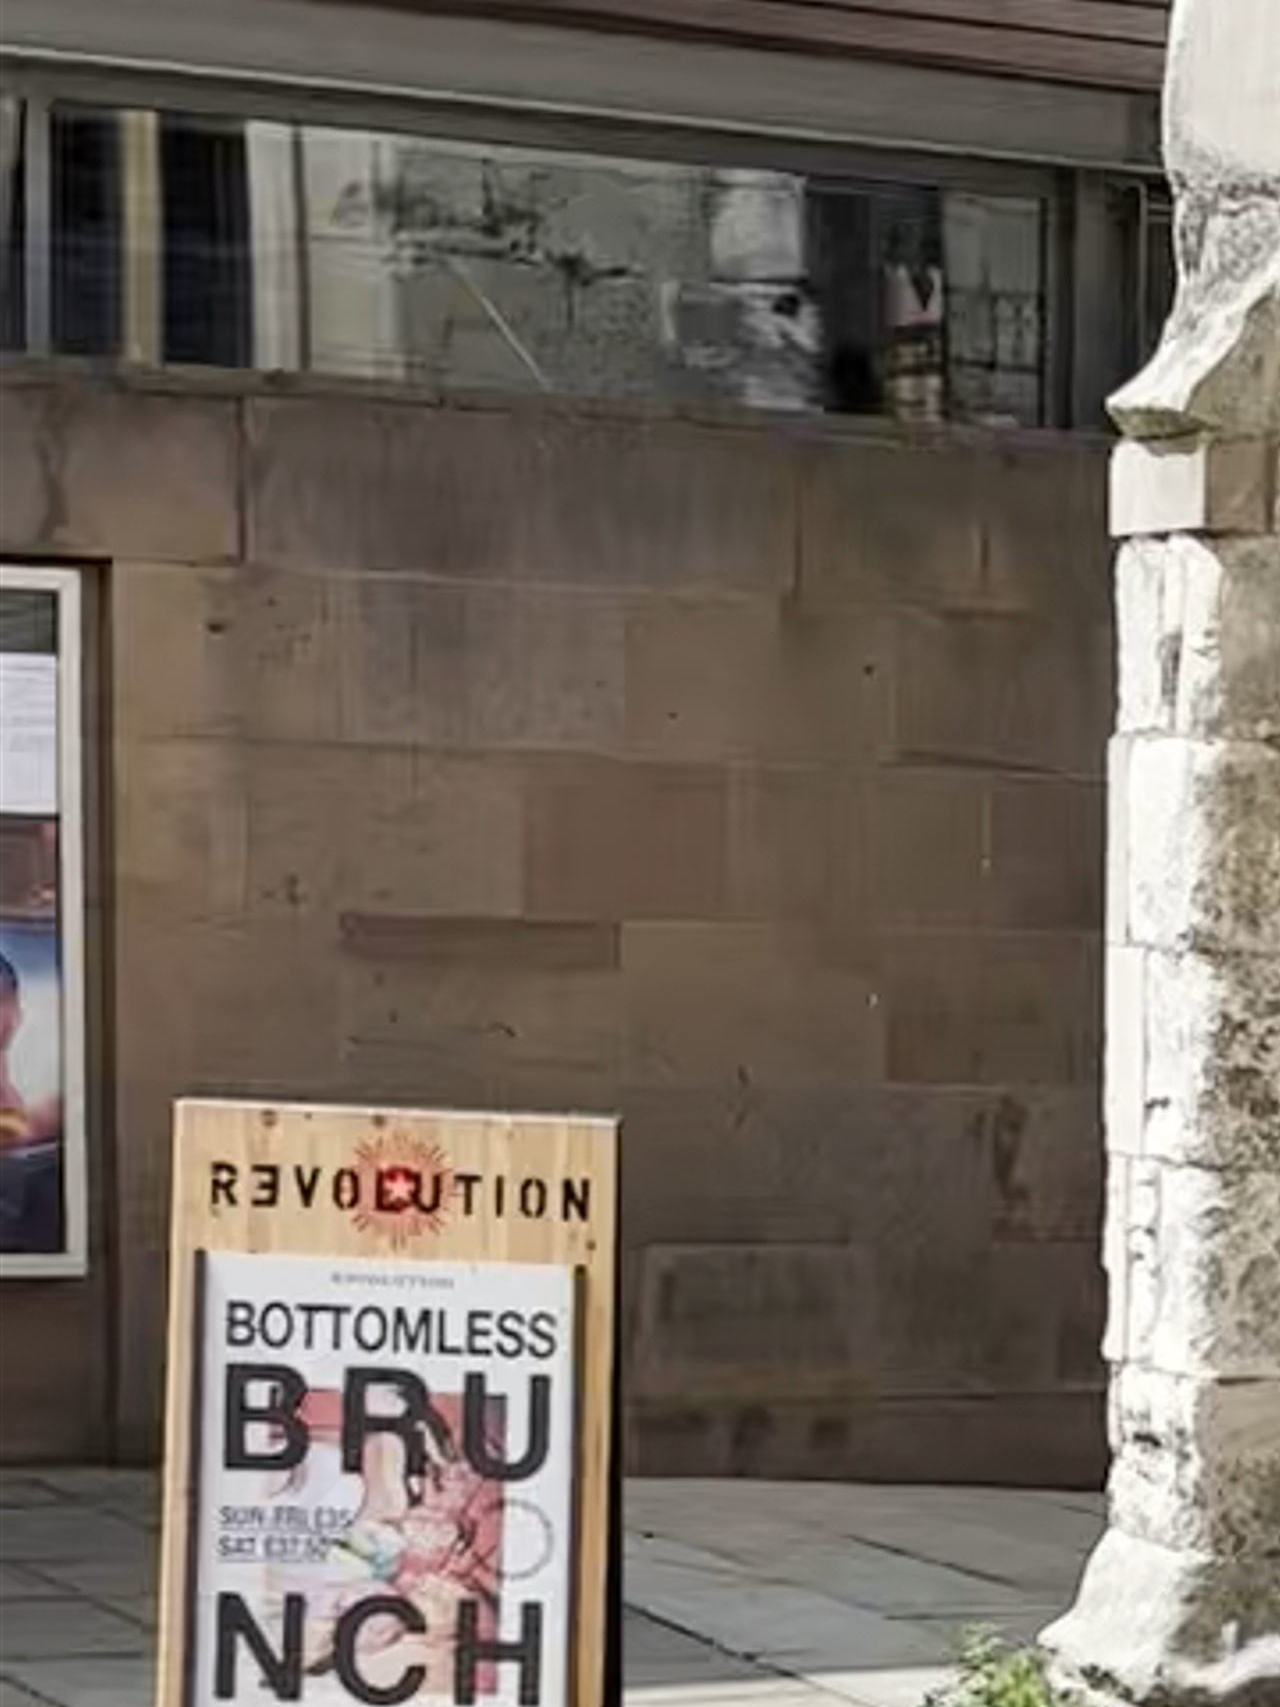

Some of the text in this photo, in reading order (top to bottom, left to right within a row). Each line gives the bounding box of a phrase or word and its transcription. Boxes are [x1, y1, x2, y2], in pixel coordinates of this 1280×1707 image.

[210, 1161, 591, 1221] REVOLUTION
[225, 1300, 558, 1360] BOTTOMLESS
[222, 1362, 553, 1483] BRU
[213, 1591, 543, 1707] NCH
